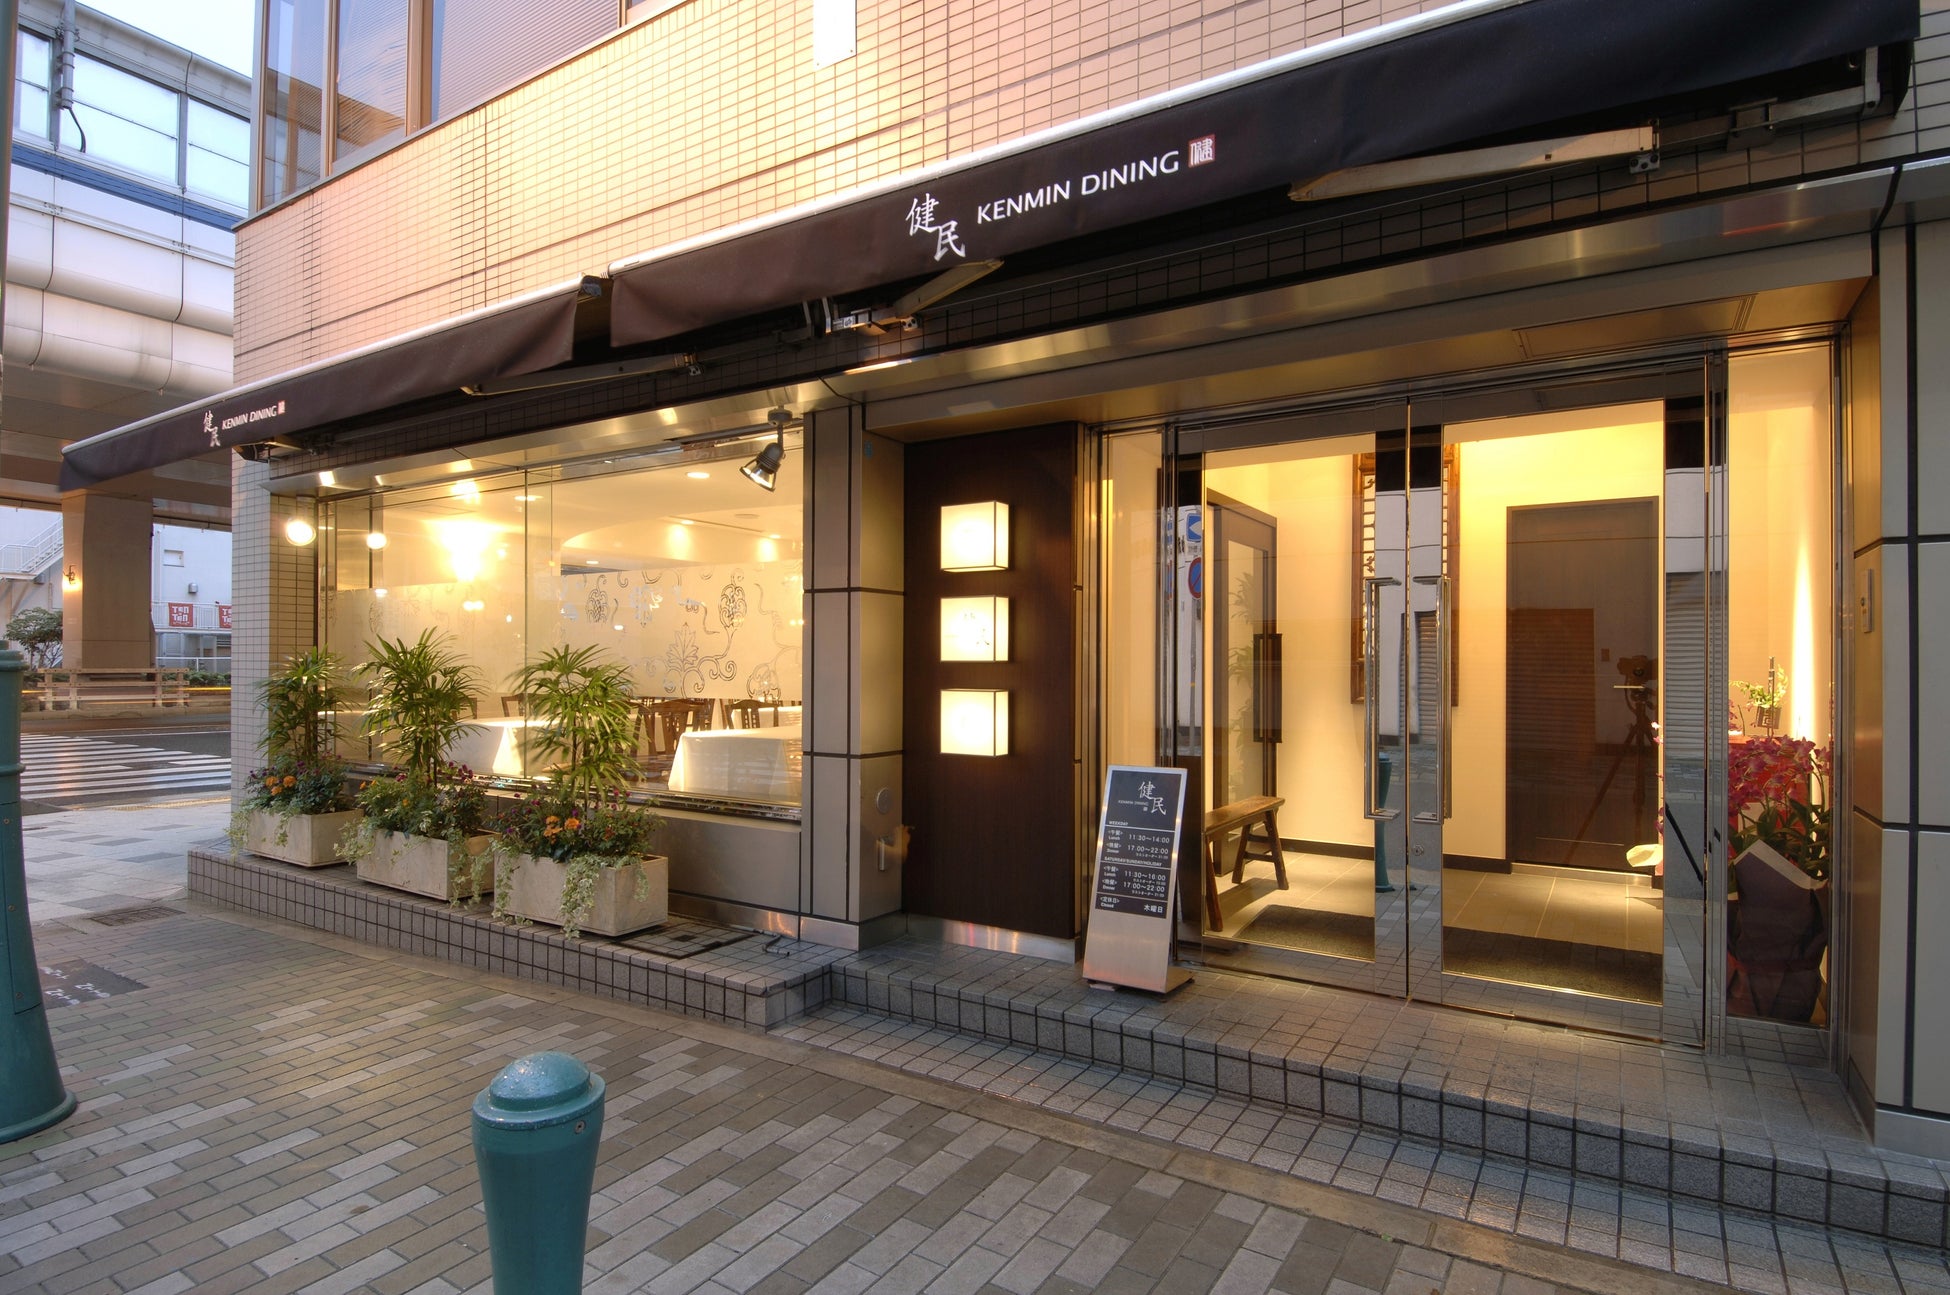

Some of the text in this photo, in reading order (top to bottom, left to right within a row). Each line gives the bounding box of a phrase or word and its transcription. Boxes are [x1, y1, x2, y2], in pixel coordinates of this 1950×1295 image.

[977, 150, 1179, 224] KENMIN DINING
[222, 413, 248, 430] KENMIN
[249, 405, 277, 422] DINING
[1143, 904, 1163, 913] 木曜日
